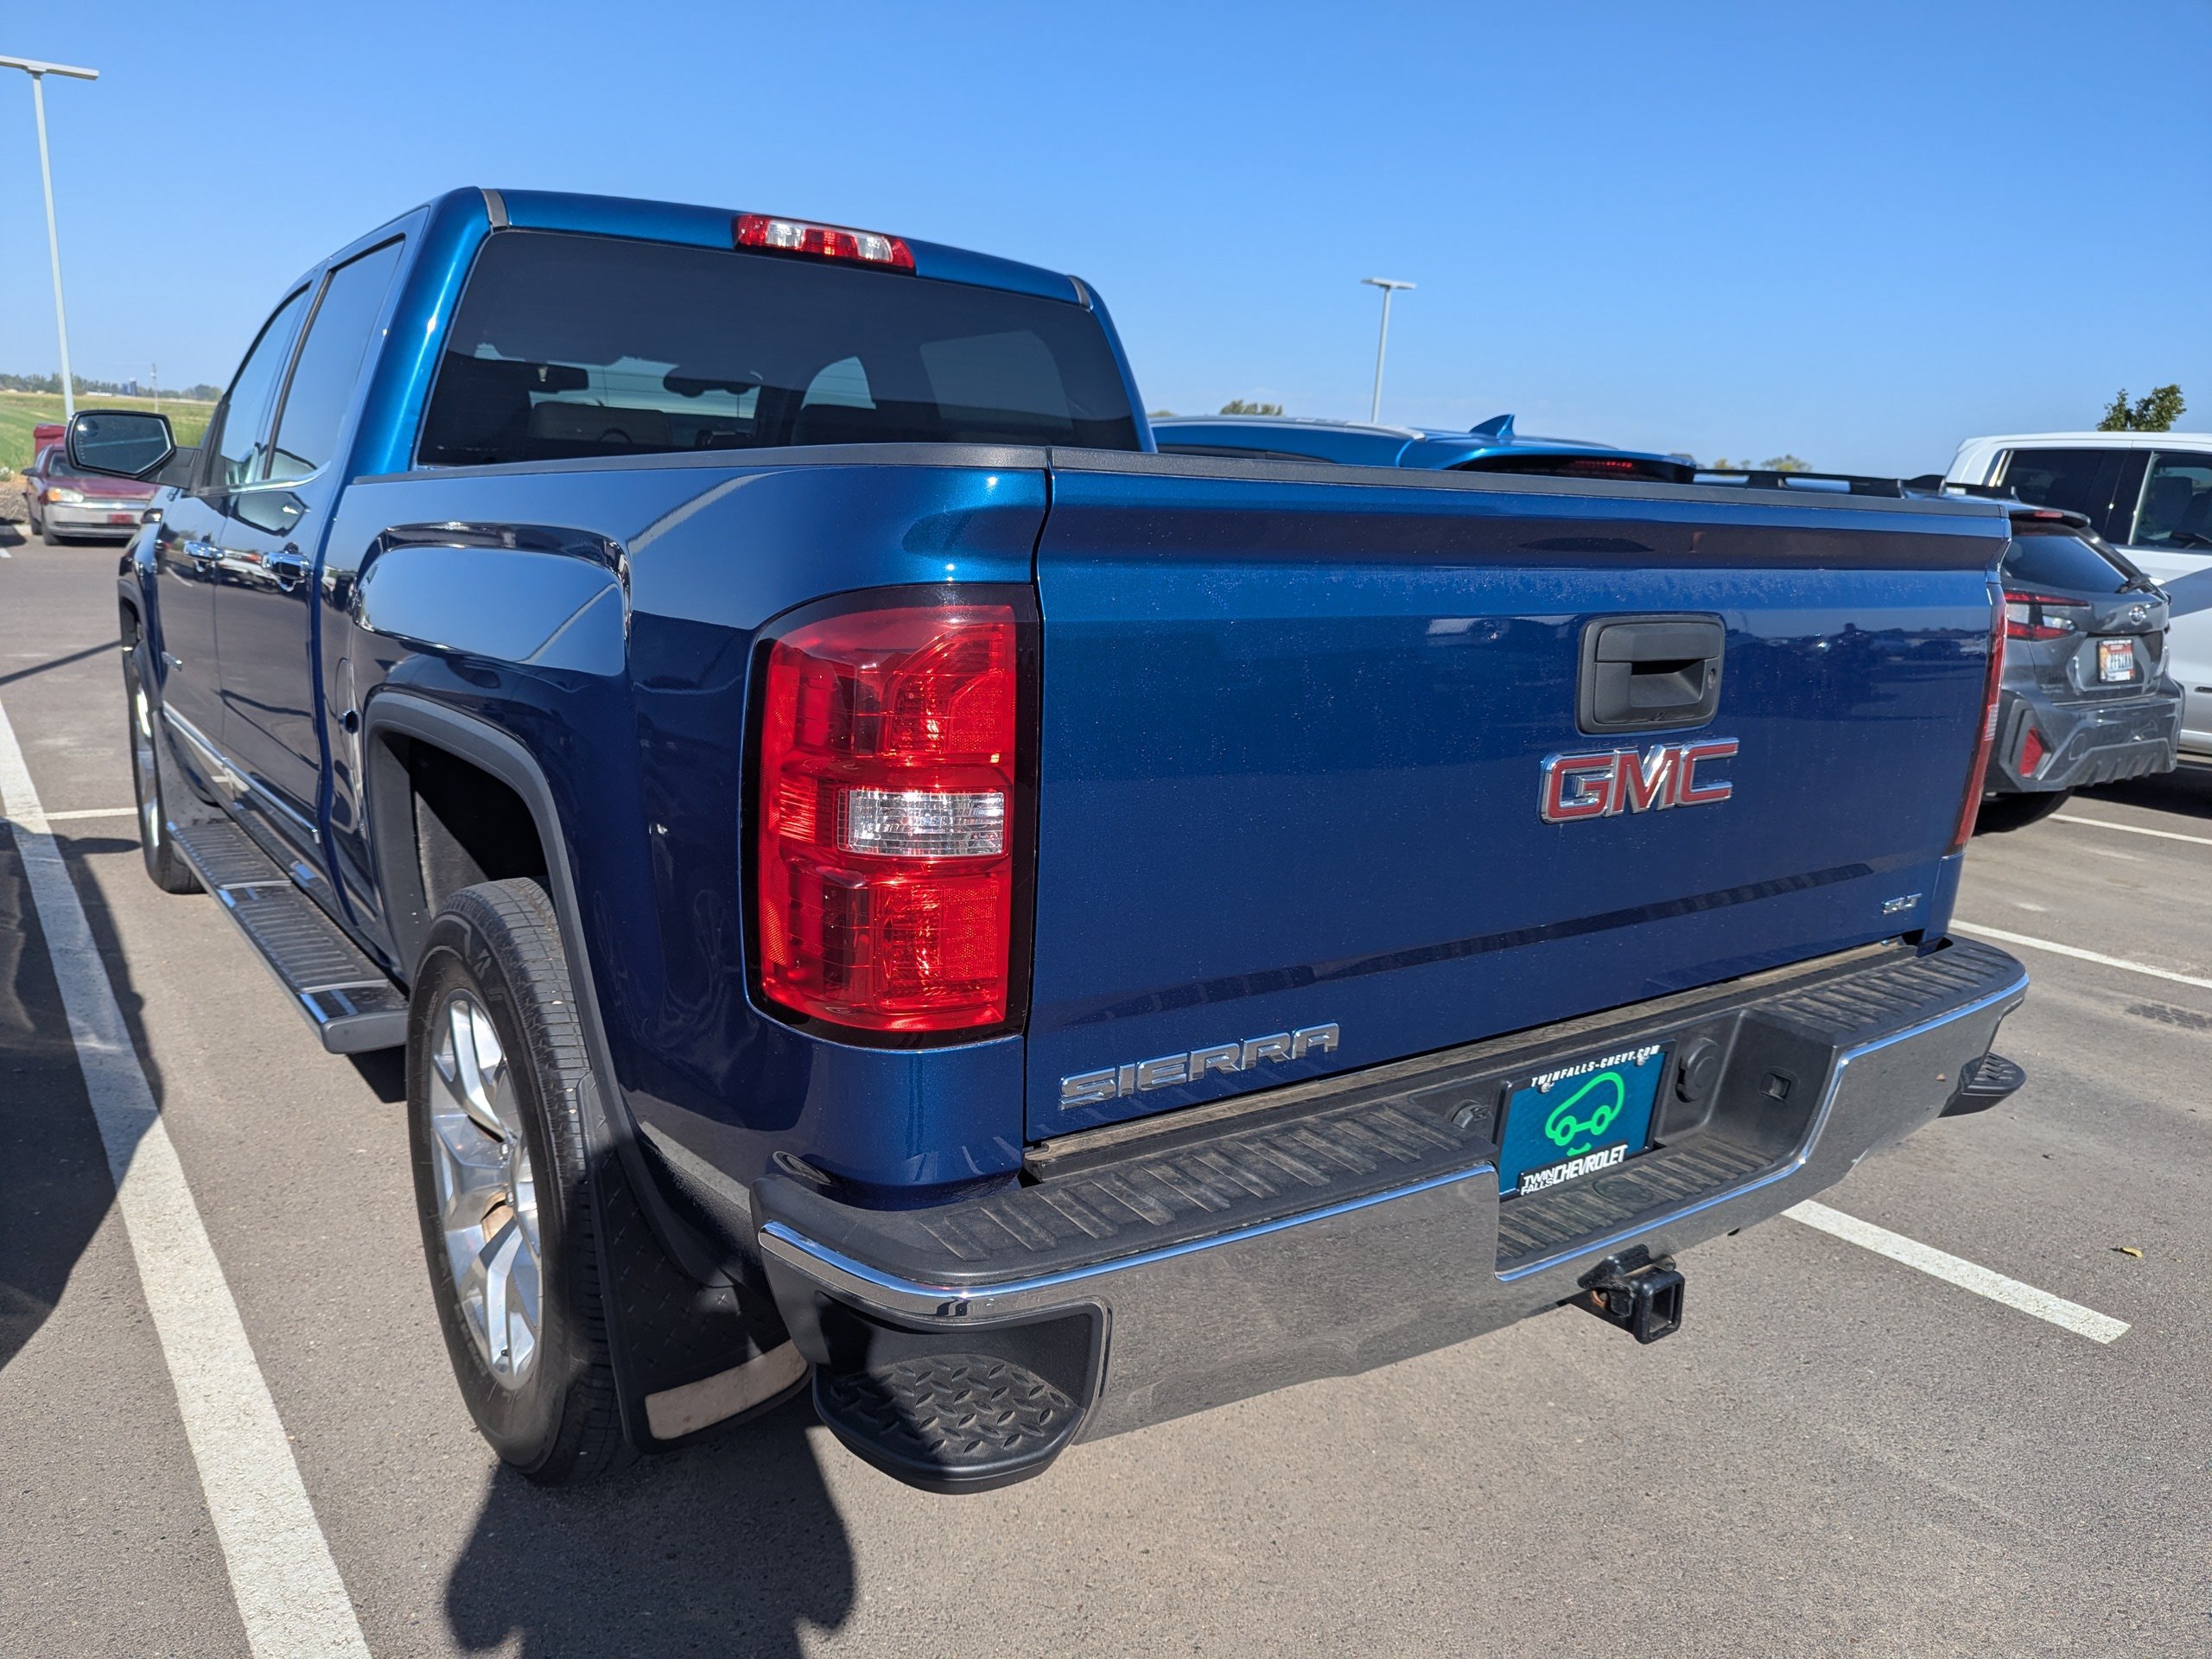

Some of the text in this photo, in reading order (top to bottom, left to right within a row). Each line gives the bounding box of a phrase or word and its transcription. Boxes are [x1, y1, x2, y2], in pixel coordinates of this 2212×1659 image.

[1539, 737, 1739, 824] GMC
[1882, 893, 1923, 915] SLT
[1059, 1022, 1340, 1111] SIERRA
[1522, 1167, 1555, 1188] TWIN
[1553, 1143, 1629, 1185] CHEVROLET
[1520, 1177, 1554, 1197] FALLS
